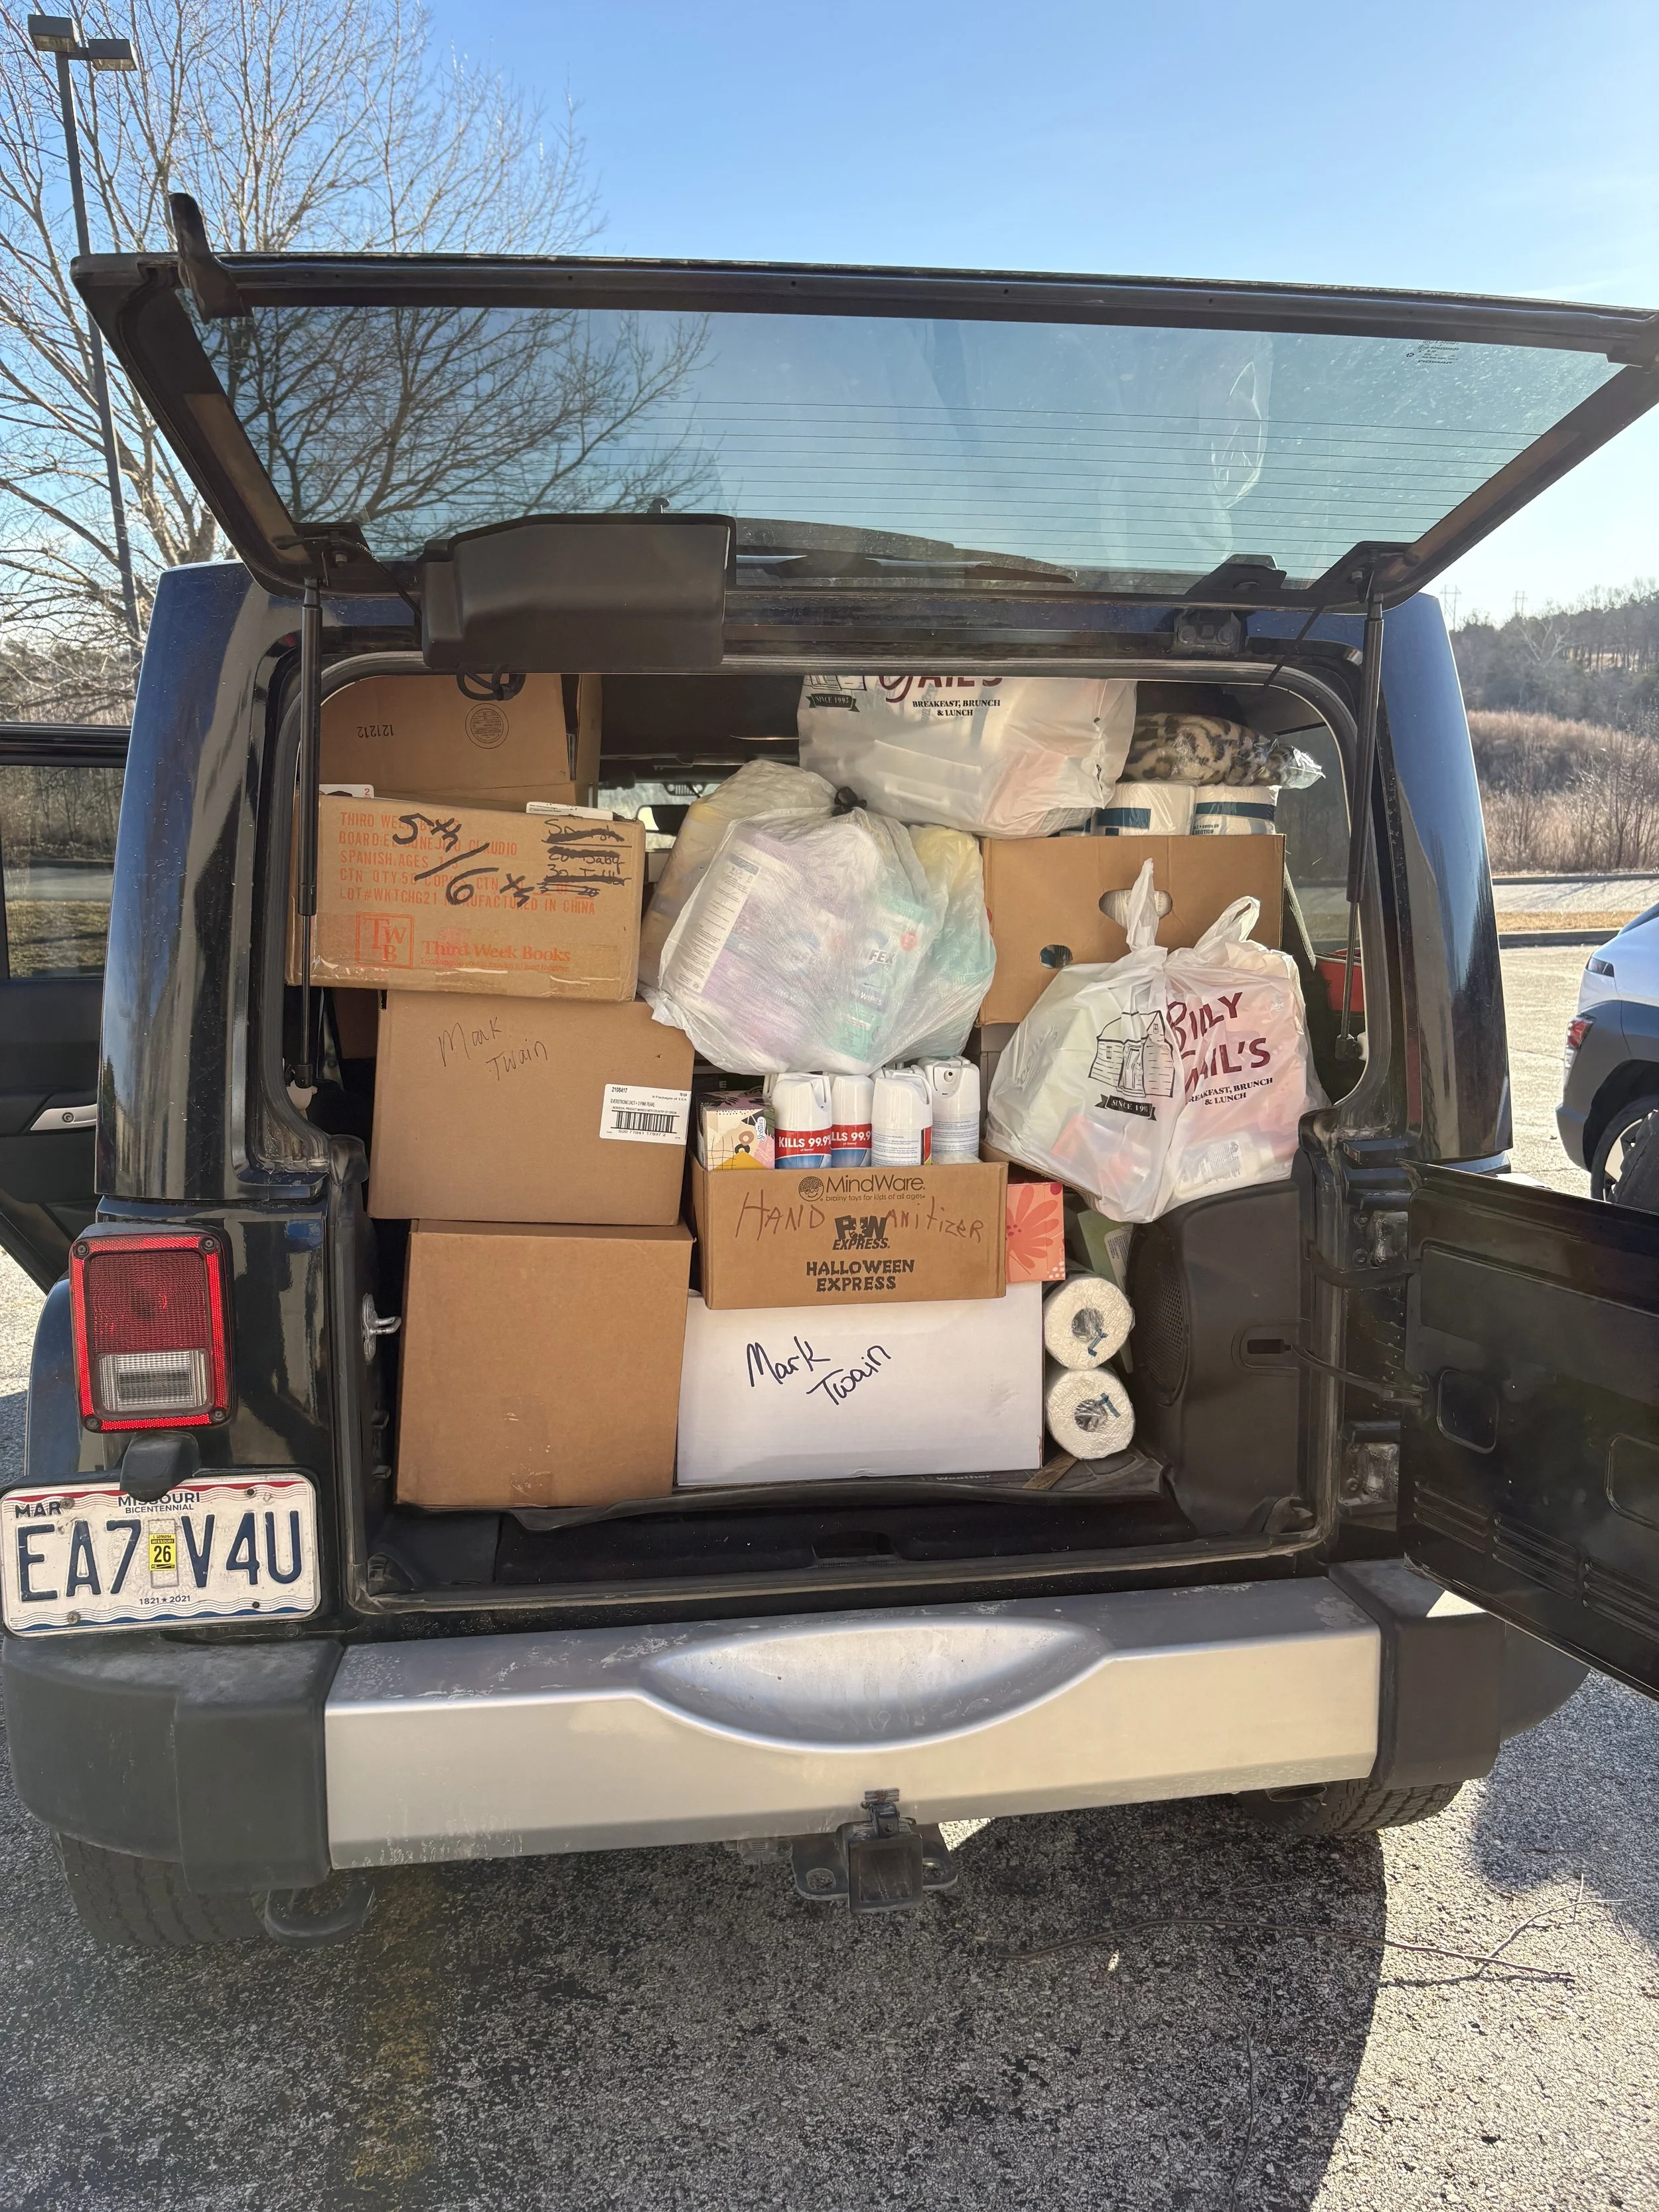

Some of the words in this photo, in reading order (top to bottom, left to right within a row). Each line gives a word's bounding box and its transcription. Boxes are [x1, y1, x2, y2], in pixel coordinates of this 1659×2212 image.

[912, 700, 961, 709] BREAKFAST,
[340, 812, 374, 828] THIRD
[340, 867, 363, 883] CTN
[476, 876, 498, 891] CTN
[545, 898, 556, 912] IN
[563, 899, 595, 915] CHINA
[423, 940, 469, 956] Third
[473, 943, 518, 959] Week
[522, 946, 571, 962] Books
[485, 1039, 548, 1081] Twain
[1189, 1086, 1233, 1102] REAKFAST,
[1233, 1077, 1273, 1092] BRUNCH
[1214, 1092, 1246, 1104] LUNCH
[1111, 1099, 1133, 1110] SINCE
[757, 1118, 766, 1142] Scotties
[831, 1131, 848, 1142] LLS
[778, 1136, 805, 1148] KILLS
[806, 1259, 915, 1276] HALLOWEEN
[816, 1276, 897, 1292] EXPRESS
[745, 1335, 831, 1388] Mark
[806, 1344, 892, 1405] Twain
[15, 1501, 62, 1518] MAR
[125, 1504, 194, 1514] BICENTENNIAL
[17, 1519, 142, 1602] EA7
[181, 1510, 303, 1588] V4U
[153, 1545, 171, 1563] 26
[139, 1597, 160, 1605] 1821
[169, 1595, 191, 1604] 2021
